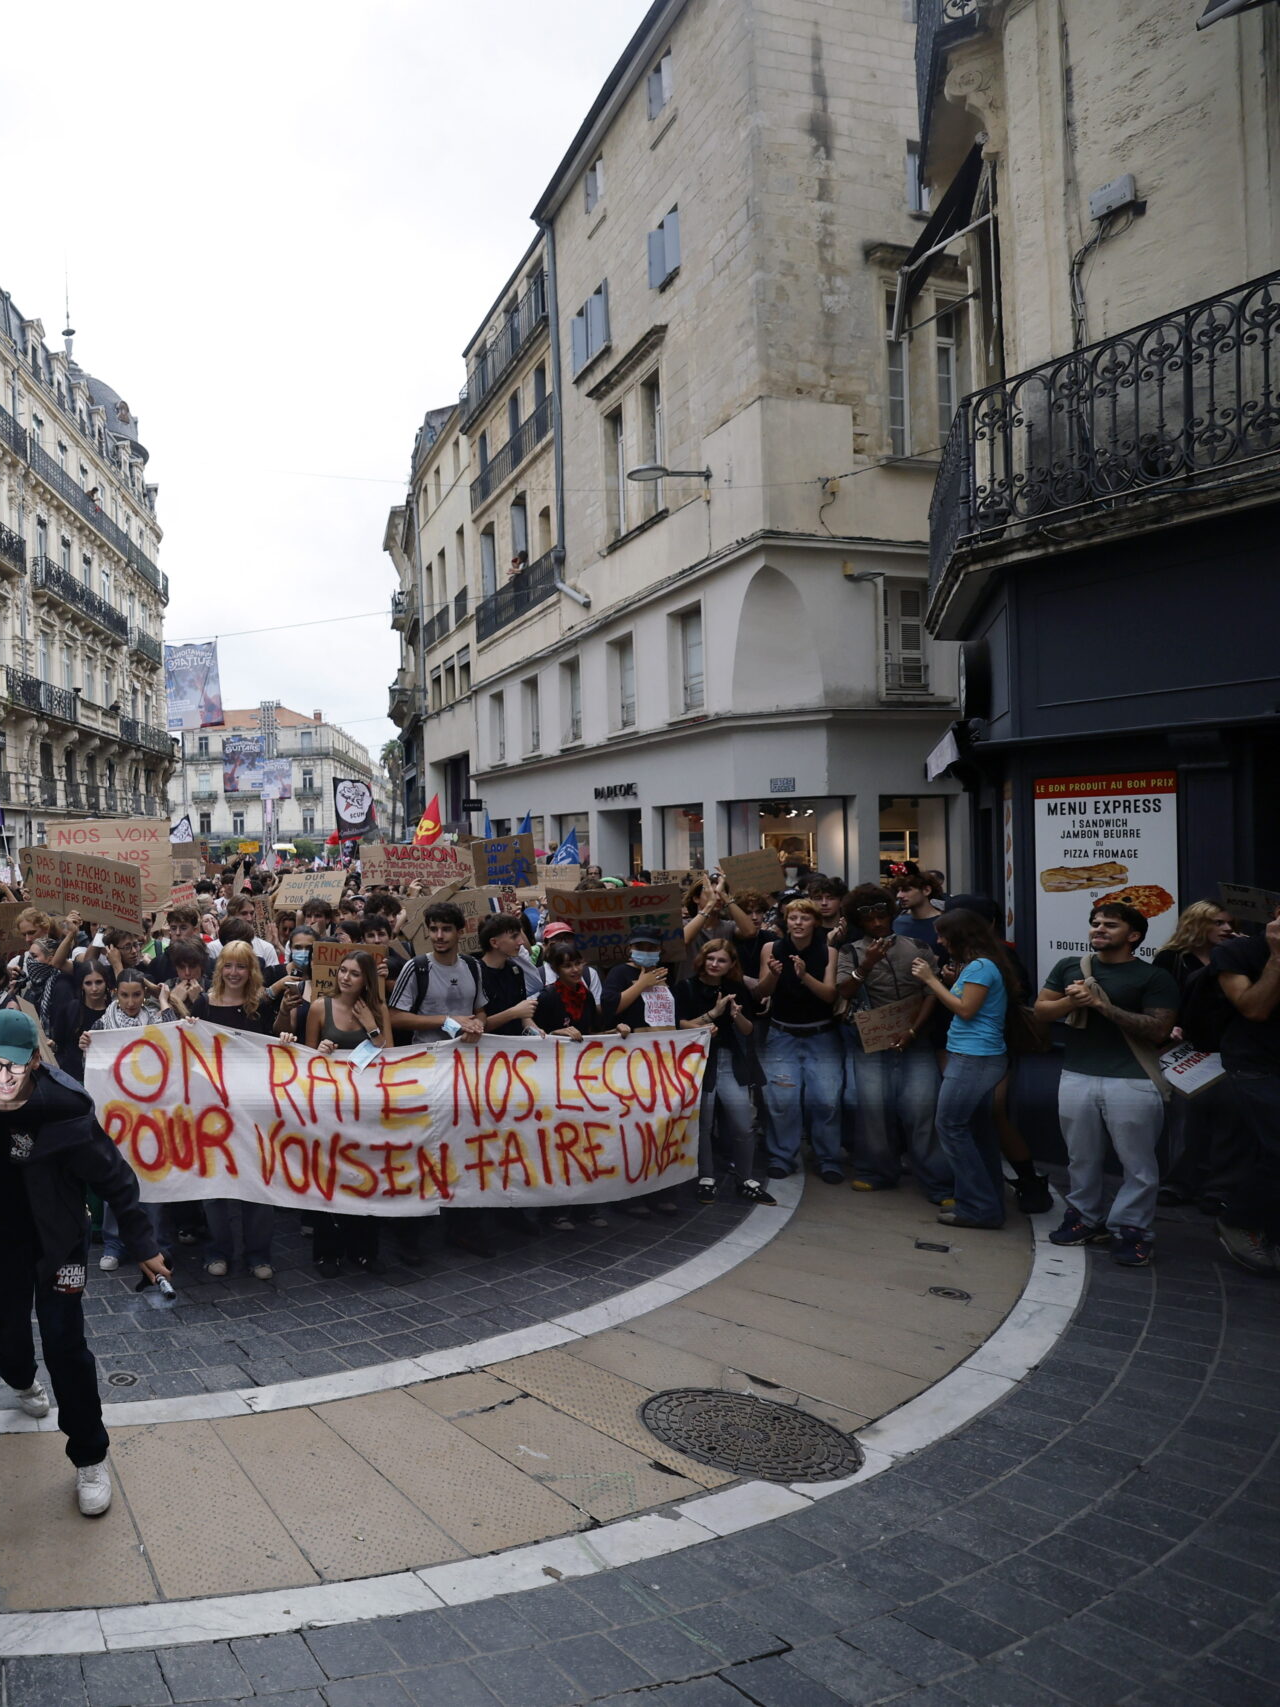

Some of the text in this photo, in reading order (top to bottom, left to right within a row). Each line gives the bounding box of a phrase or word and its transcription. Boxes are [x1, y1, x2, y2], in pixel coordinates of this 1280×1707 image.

[1036, 777, 1174, 793] LE BON PRODUIT AU BON PRIX
[1047, 799, 1162, 816] MENU EXPRESS
[1072, 819, 1128, 829] 1 SANDWICH
[57, 828, 160, 846] NOS VOIX
[1060, 829, 1141, 839] JAMBON BEURRE
[117, 850, 151, 863] NOS
[383, 846, 457, 863] MACRON
[1064, 849, 1138, 859] PIZZA FROMAGE
[36, 855, 55, 871] PAS
[59, 860, 72, 874] DE
[76, 863, 110, 883] FACHOS
[114, 871, 136, 888] DANS
[305, 873, 326, 881] OUR
[36, 873, 51, 885] NOS
[111, 888, 125, 905] PAS
[129, 893, 139, 907] DE
[285, 880, 343, 890] SOUFFRANCE
[35, 887, 79, 904] QUARTIERS
[82, 895, 99, 908] POUR
[285, 895, 304, 903] YOUR
[552, 896, 582, 914] ON
[586, 895, 625, 913] VEUT
[579, 916, 624, 932] NOTRE
[113, 1026, 707, 1126] ON RATE NOS LEÇONS
[102, 1105, 237, 1178] POUR
